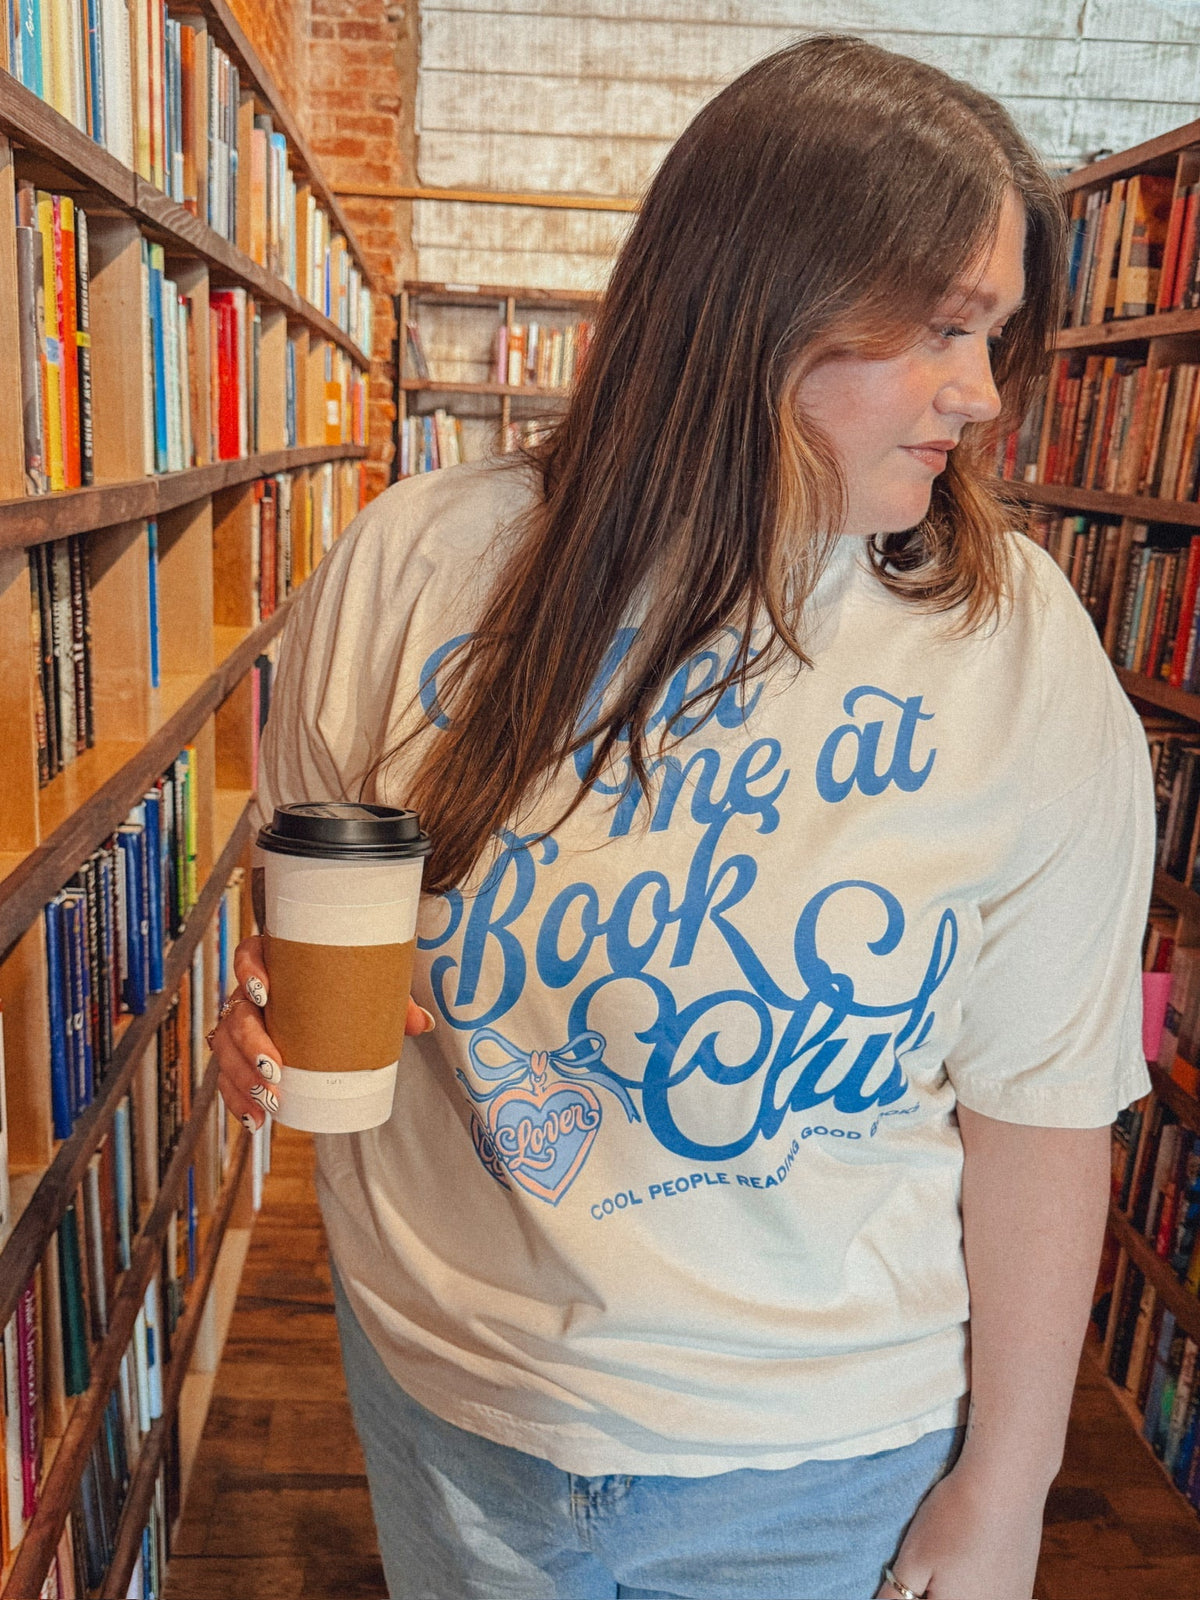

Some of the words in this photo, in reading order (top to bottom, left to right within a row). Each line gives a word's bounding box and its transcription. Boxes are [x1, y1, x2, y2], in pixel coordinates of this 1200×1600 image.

[815, 684, 937, 804] at
[417, 803, 795, 1031] Book
[493, 1102, 600, 1172] Lover
[590, 1189, 643, 1221] COOL
[648, 1172, 730, 1200] PEOPLE
[736, 1138, 800, 1189] READING
[801, 1125, 862, 1140] GOOD
